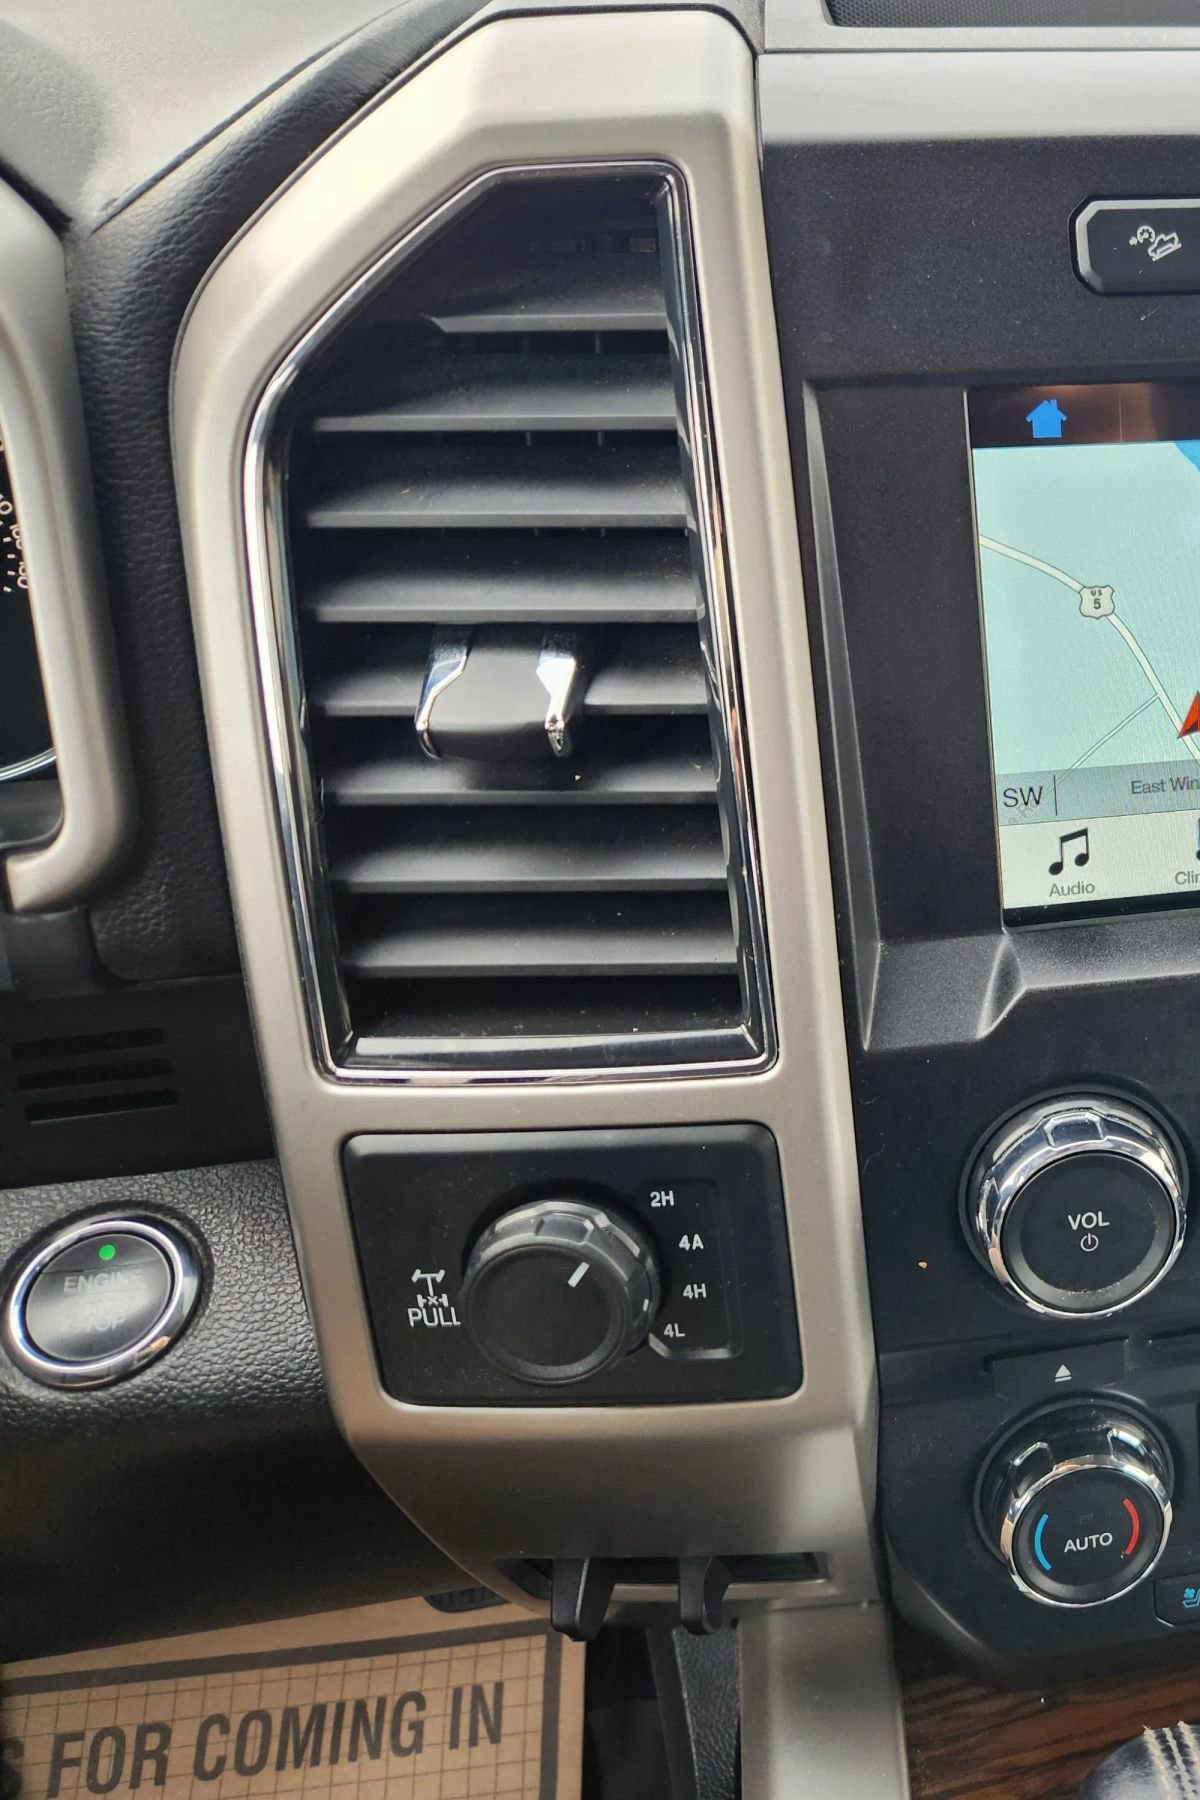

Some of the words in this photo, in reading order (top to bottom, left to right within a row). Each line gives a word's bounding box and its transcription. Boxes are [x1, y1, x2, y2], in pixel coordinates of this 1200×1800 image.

[1093, 598, 1102, 610] 5
[1131, 778, 1167, 795] East
[1003, 786, 1043, 807] SW
[1049, 881, 1096, 898] Audio
[649, 1190, 675, 1208] 2H
[1067, 1210, 1110, 1231] VOL
[678, 1234, 705, 1250] 4A
[63, 1266, 144, 1292] ENGINE
[682, 1283, 708, 1300] 4H
[407, 1307, 462, 1328] PULL
[663, 1323, 686, 1338] 4L
[1063, 1531, 1114, 1553] AUTO
[46, 1722, 174, 1799] FOR
[192, 1690, 427, 1782] COMING
[448, 1680, 506, 1751] IN
